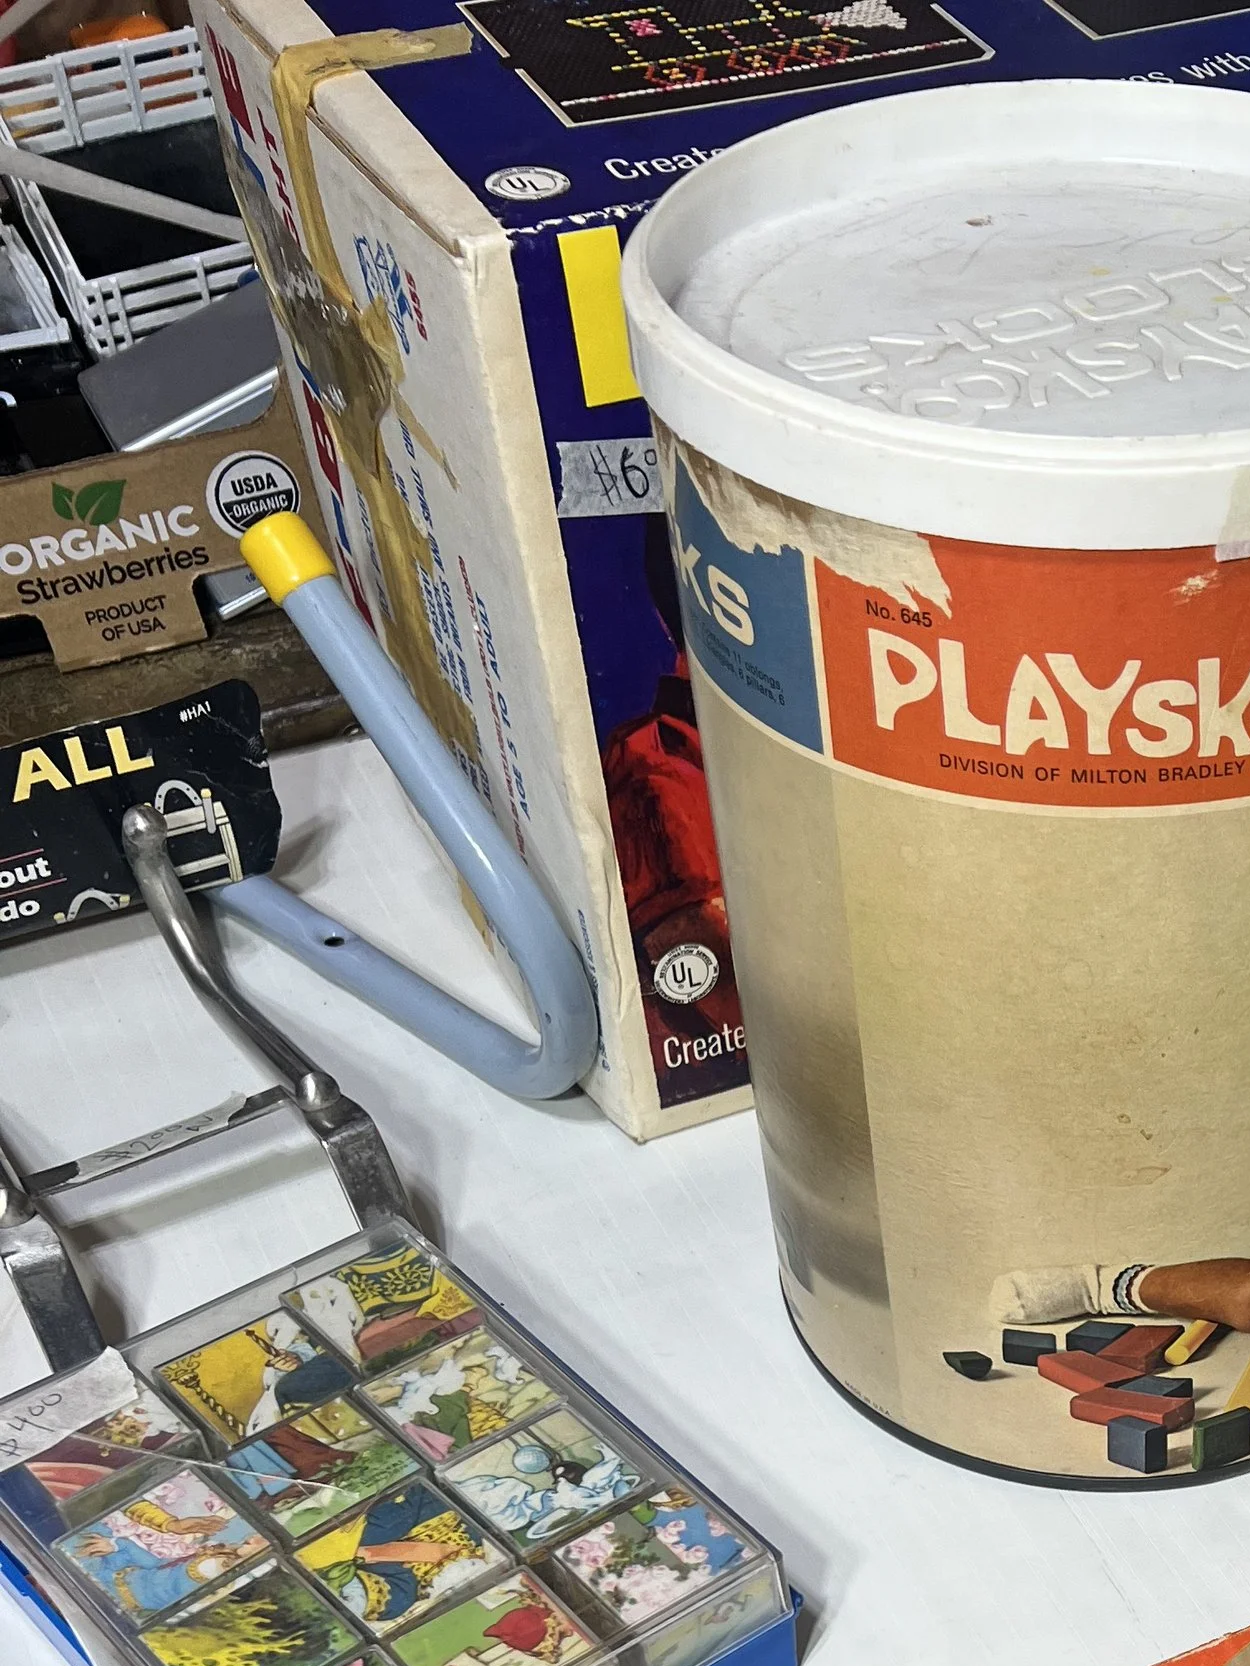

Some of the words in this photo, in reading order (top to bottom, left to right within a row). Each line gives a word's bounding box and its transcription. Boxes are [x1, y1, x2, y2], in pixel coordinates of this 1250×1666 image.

[230, 472, 278, 497] USDA
[232, 494, 289, 518] ORGANIC
[0, 505, 199, 575] ORGANIC
[17, 546, 210, 604] Strawberries
[86, 595, 167, 626] PRODUCT
[102, 625, 125, 641] OF
[128, 616, 166, 637] USA
[865, 600, 896, 622] No.
[901, 608, 933, 627] 645
[474, 589, 501, 681] ADULT
[495, 687, 512, 731] TO
[12, 726, 156, 803] ALL
[939, 753, 1024, 780] DIVISION
[1034, 767, 1060, 783] OF
[1071, 767, 1148, 785] MILTON
[1158, 760, 1246, 783] BRADLEY
[511, 761, 530, 820] AGE
[671, 961, 702, 988] UL
[663, 1023, 747, 1068] Create
